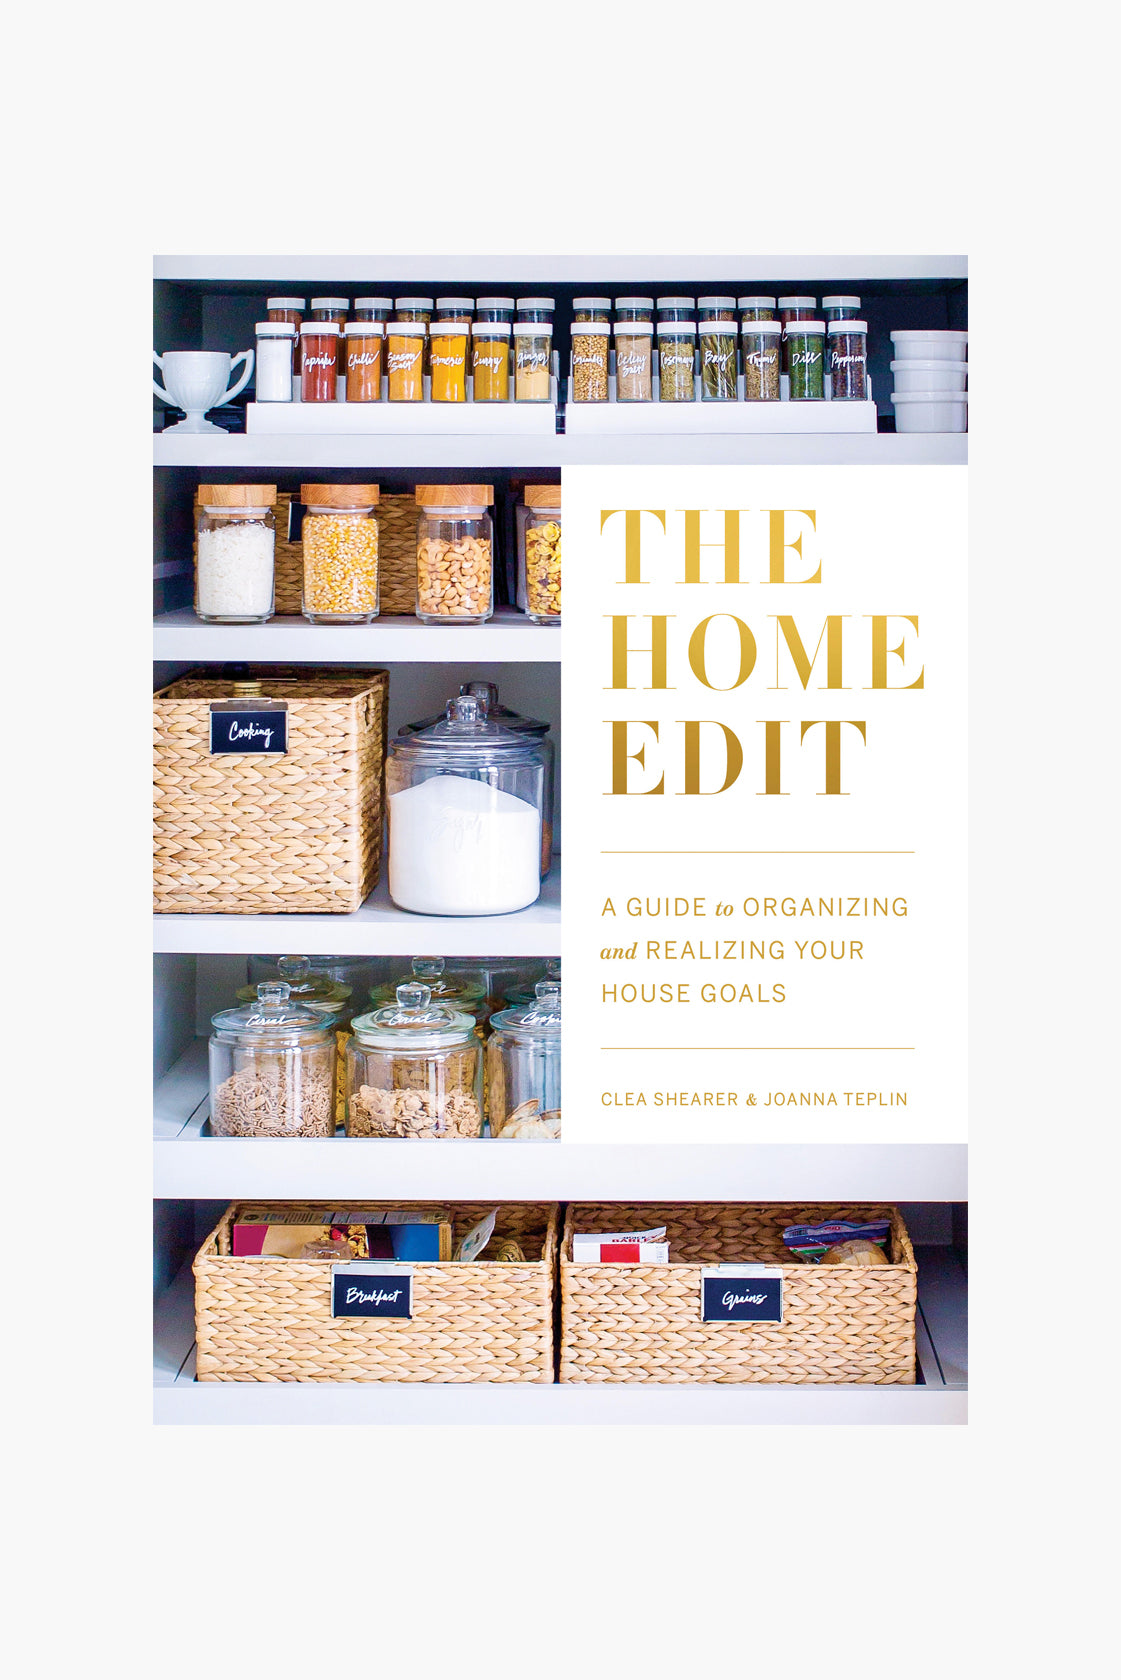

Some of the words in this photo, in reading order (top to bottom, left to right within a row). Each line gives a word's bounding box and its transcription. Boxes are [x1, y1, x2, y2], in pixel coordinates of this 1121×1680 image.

[473, 351, 504, 373] Curry
[704, 350, 733, 371] Bay
[792, 352, 822, 367] Dill
[600, 510, 821, 584] THE
[602, 613, 924, 691] HOME
[228, 720, 274, 748] Cooking
[602, 721, 866, 795] EDIT
[602, 897, 616, 916] A
[627, 897, 706, 916] GUIDE
[715, 902, 733, 916] to
[743, 897, 908, 916] ORGANIZING
[600, 941, 638, 960] and
[646, 940, 785, 960] REALIZING
[795, 940, 864, 960] YOUR
[602, 983, 690, 1003] HOUSE
[701, 983, 786, 1003] GOALS
[601, 1092, 647, 1107] CLEA
[654, 1092, 738, 1107] SHEARER
[746, 1092, 758, 1107] &
[764, 1092, 838, 1107] JOANNA
[843, 1092, 908, 1107] TEPLIN
[721, 1290, 768, 1312] Grains
